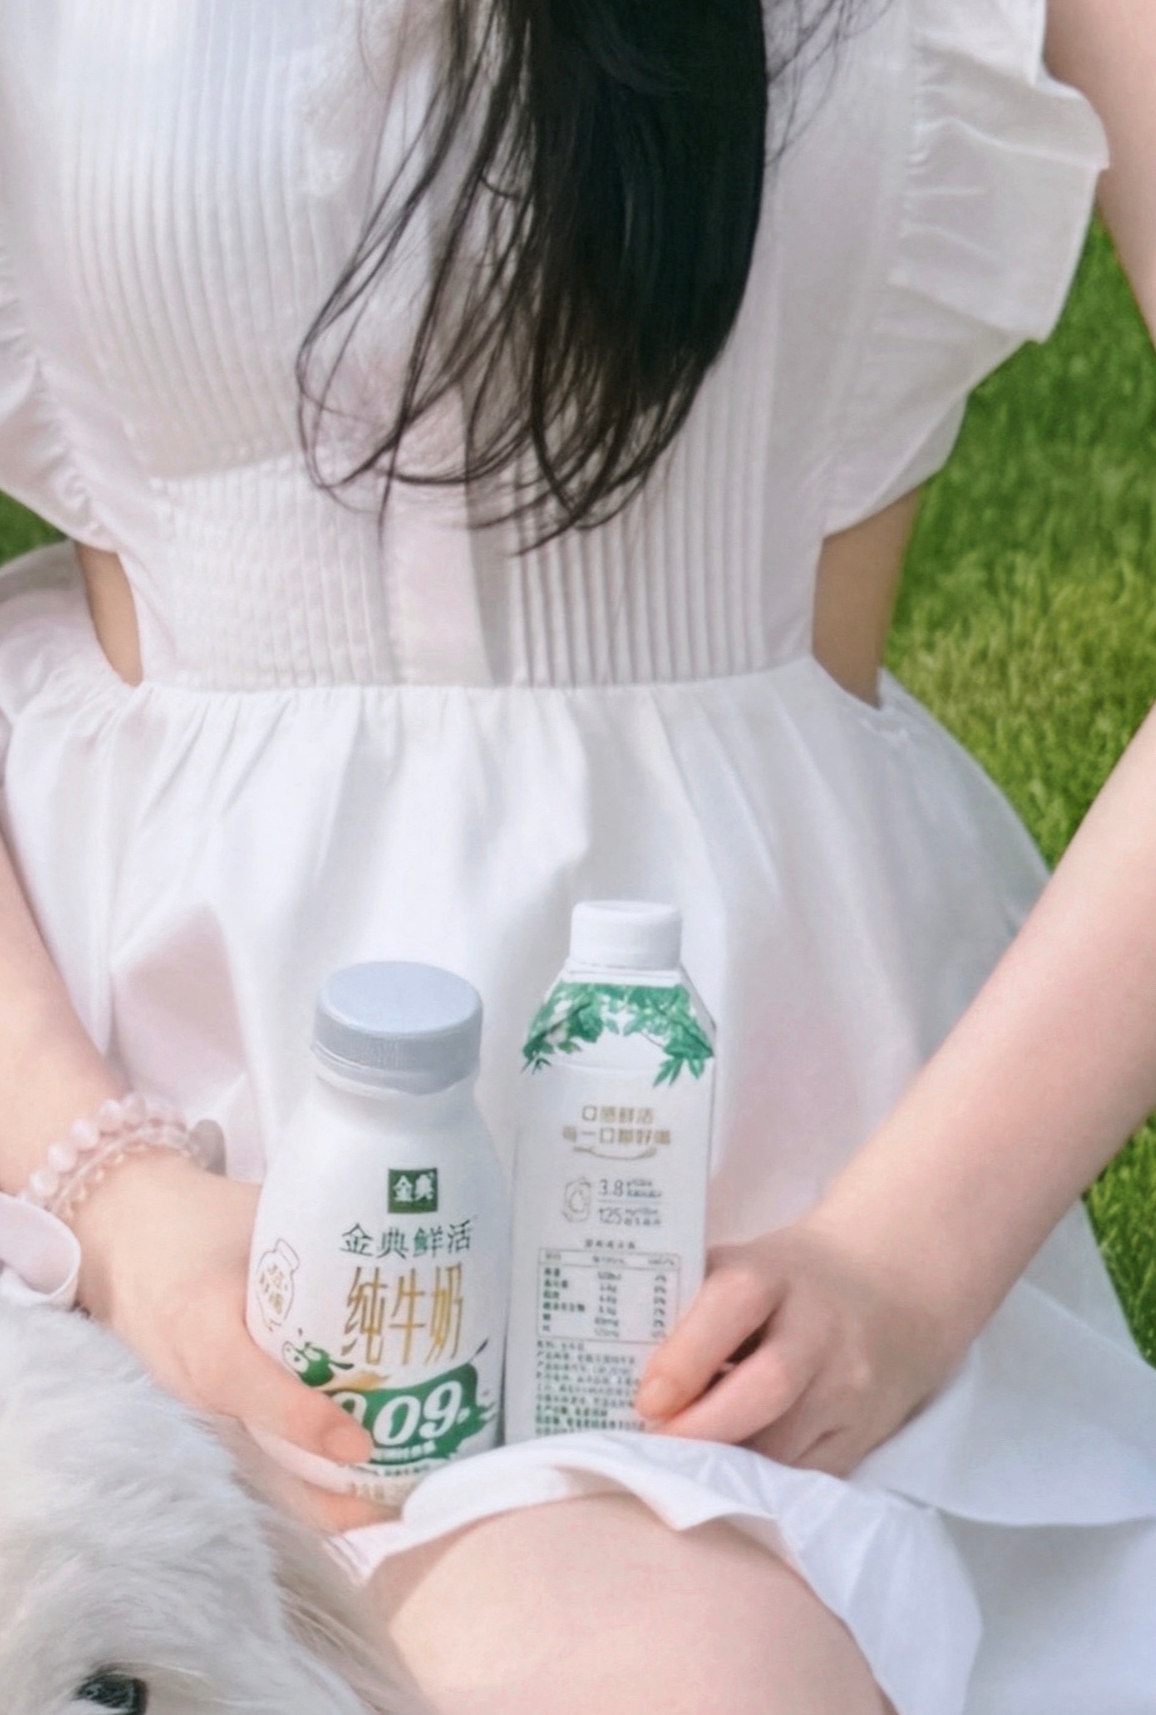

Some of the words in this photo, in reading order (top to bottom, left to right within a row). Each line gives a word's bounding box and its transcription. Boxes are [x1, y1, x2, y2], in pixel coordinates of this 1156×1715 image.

[339, 1219, 472, 1259] 金典鲜活
[341, 1262, 462, 1365] 纯牛奶
